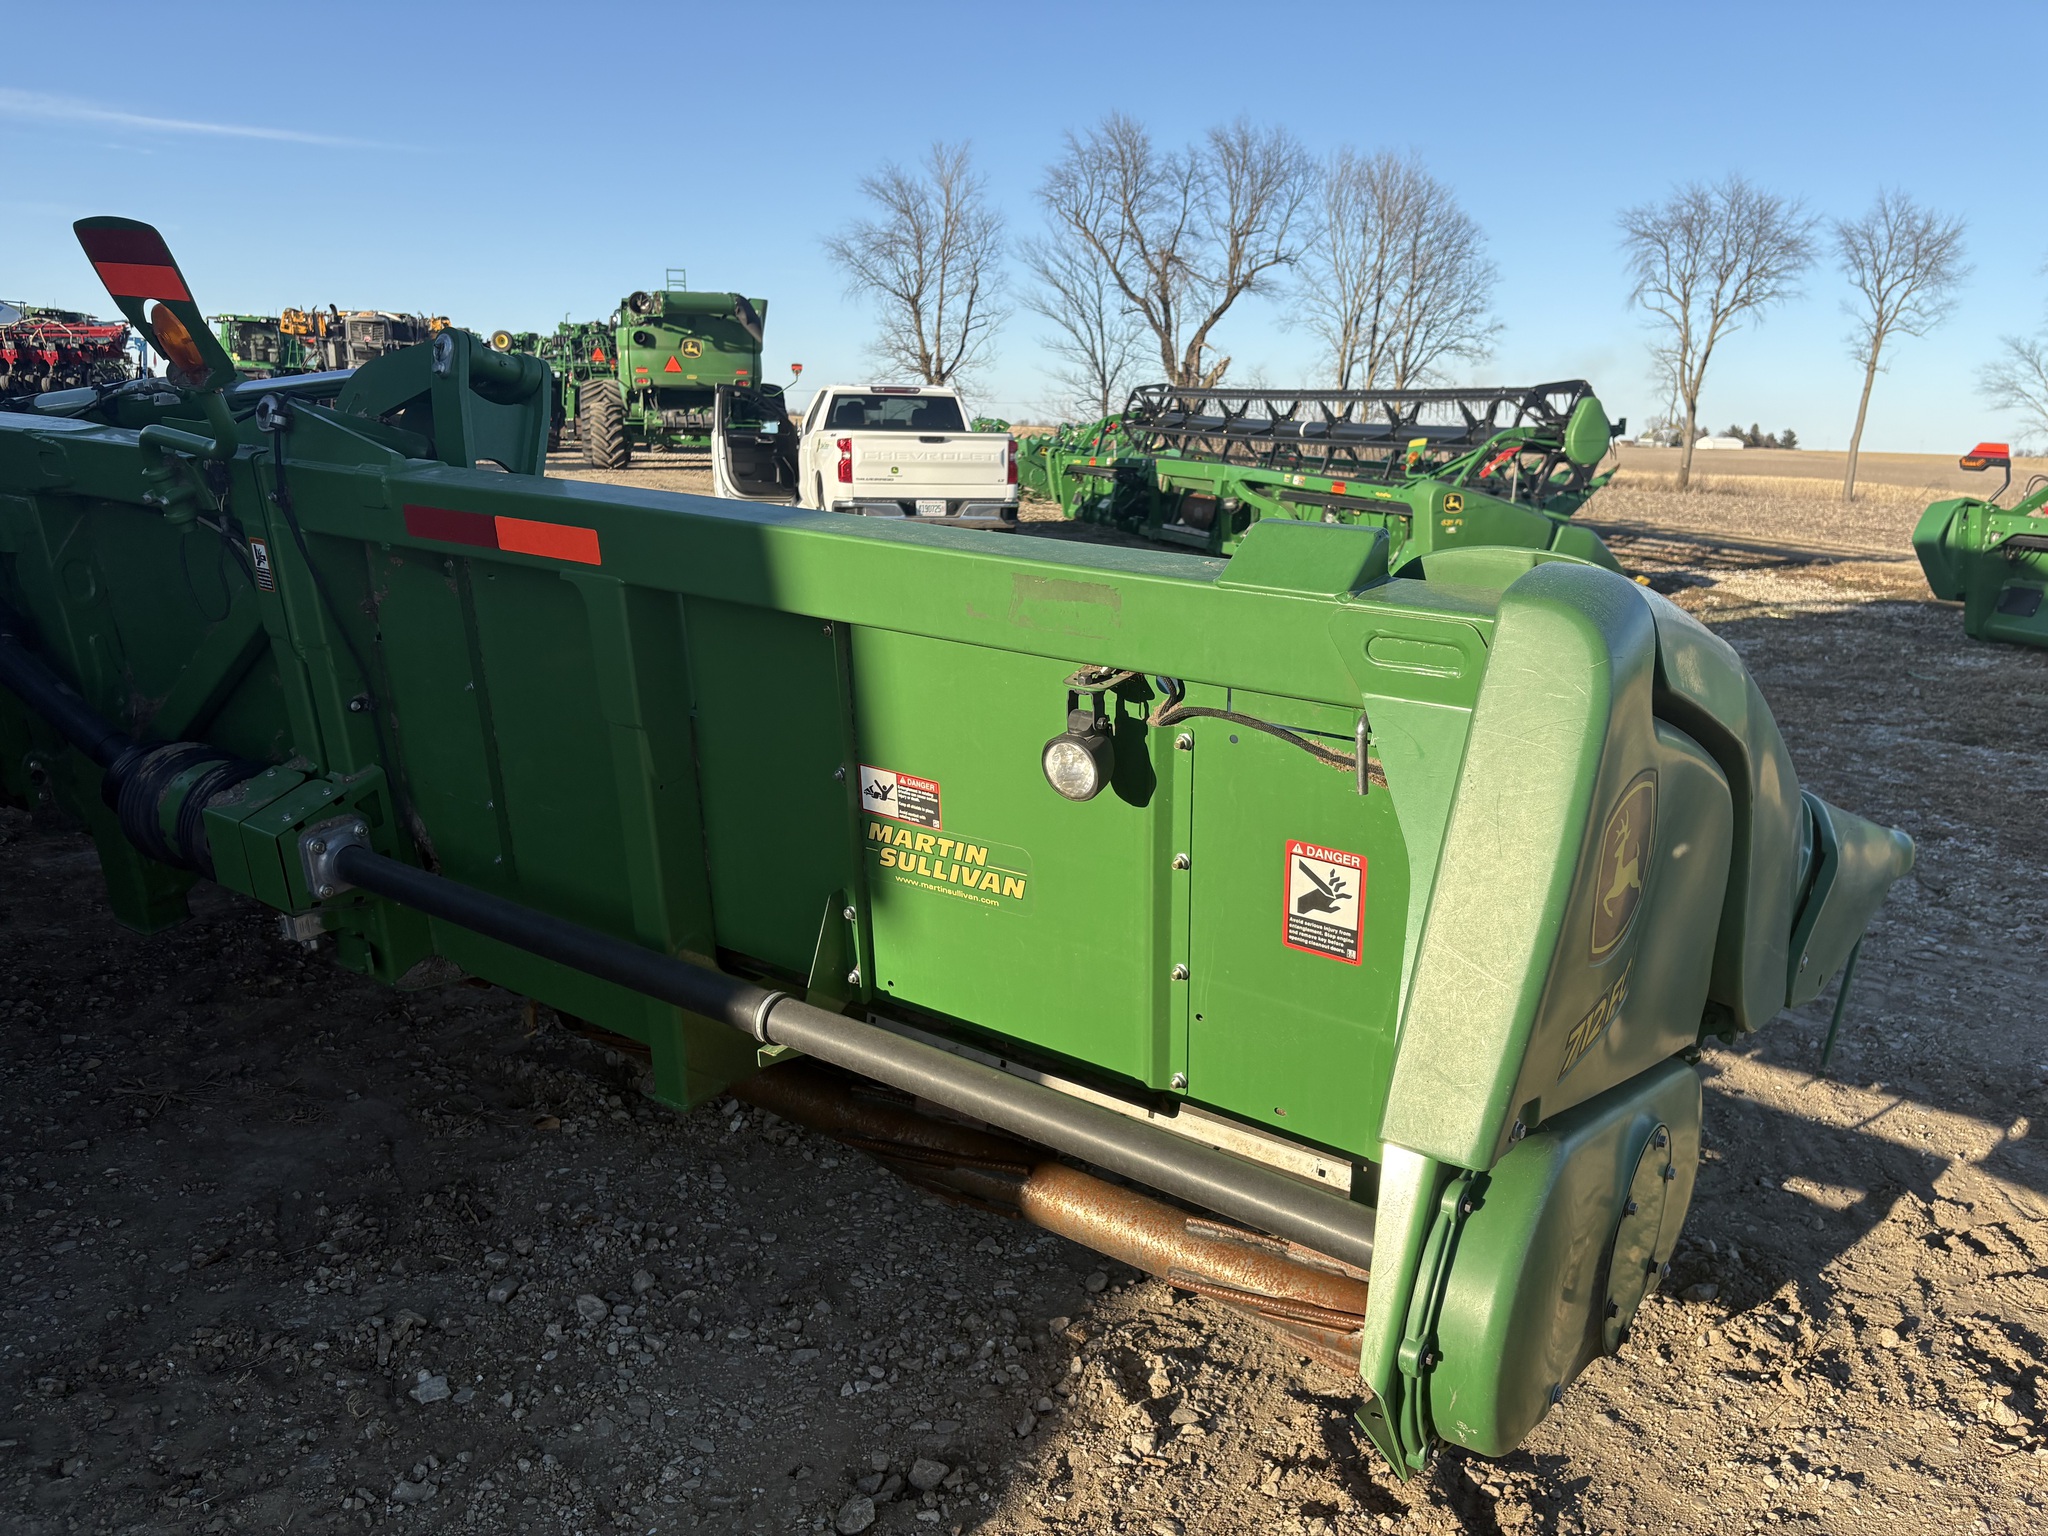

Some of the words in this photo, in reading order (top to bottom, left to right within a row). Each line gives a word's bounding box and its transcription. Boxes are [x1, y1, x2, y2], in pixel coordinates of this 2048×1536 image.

[863, 451, 996, 461] CHEVROLET
[907, 778, 934, 791] DANGER
[868, 822, 988, 867] MARTIN
[1306, 846, 1360, 867] DANGER
[879, 847, 1027, 900] SULLIVAN
[895, 875, 1000, 907] www.martinsullivan.com
[1289, 923, 1323, 936] entanglement.
[1337, 935, 1354, 944] engine
[1299, 932, 1317, 940] remove
[1305, 921, 1323, 929] serious
[1324, 926, 1338, 934] injury
[1289, 935, 1308, 944] opening
[1309, 941, 1329, 950] cleanout
